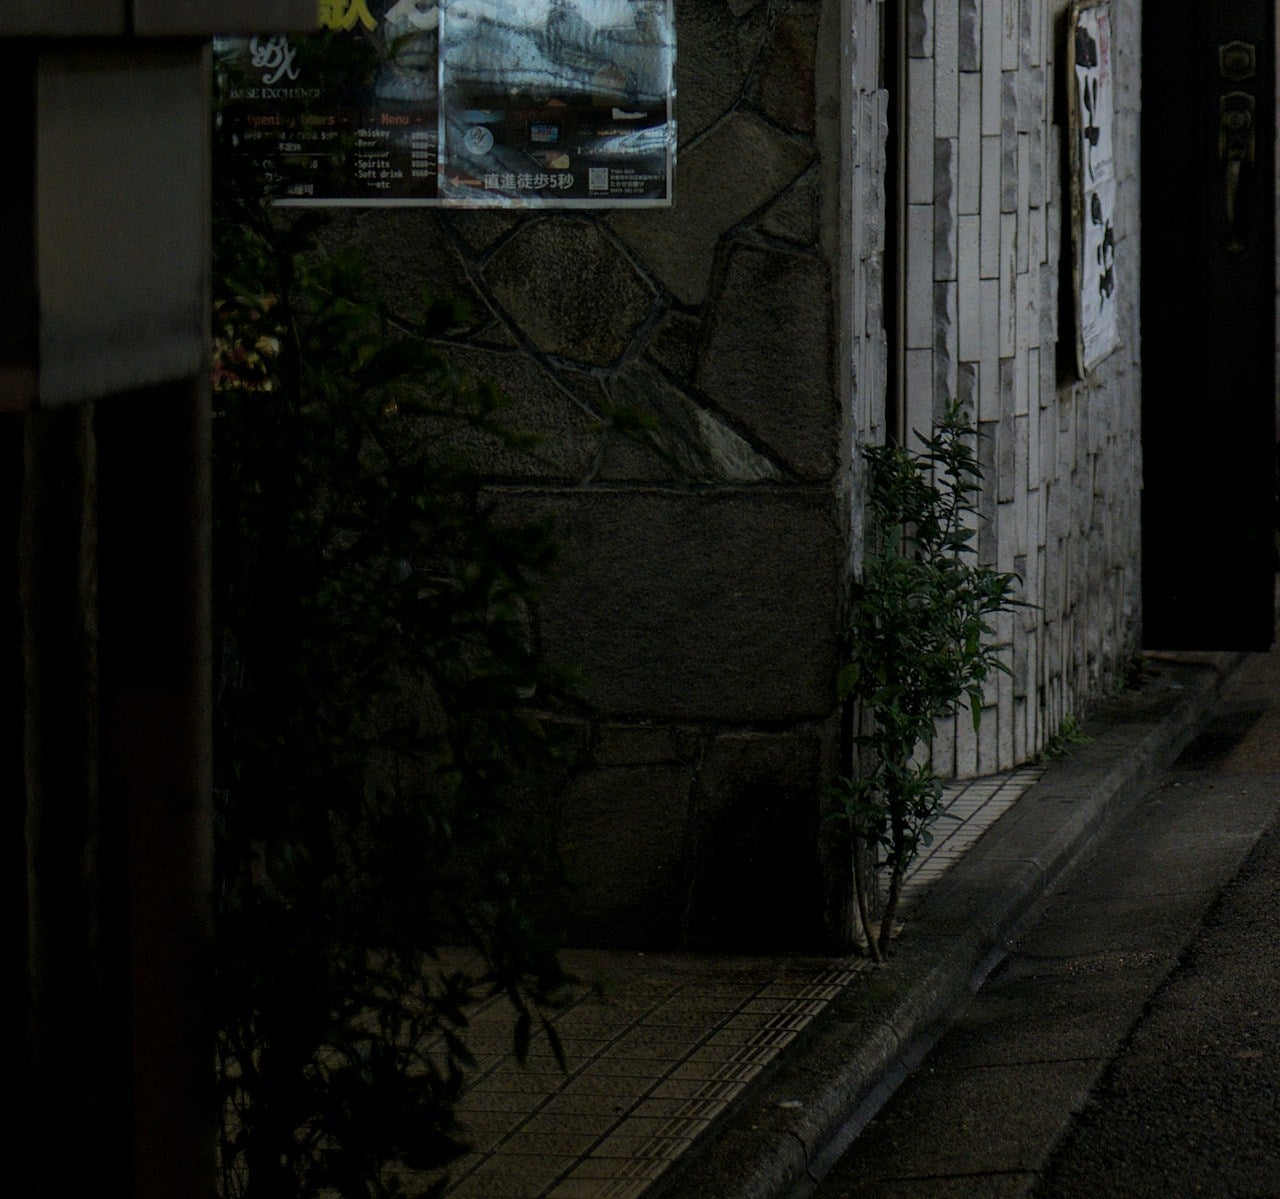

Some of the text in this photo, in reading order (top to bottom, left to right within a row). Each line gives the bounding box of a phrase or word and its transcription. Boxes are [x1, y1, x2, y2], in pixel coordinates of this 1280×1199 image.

[484, 173, 575, 191] 直進徒歩5秒
